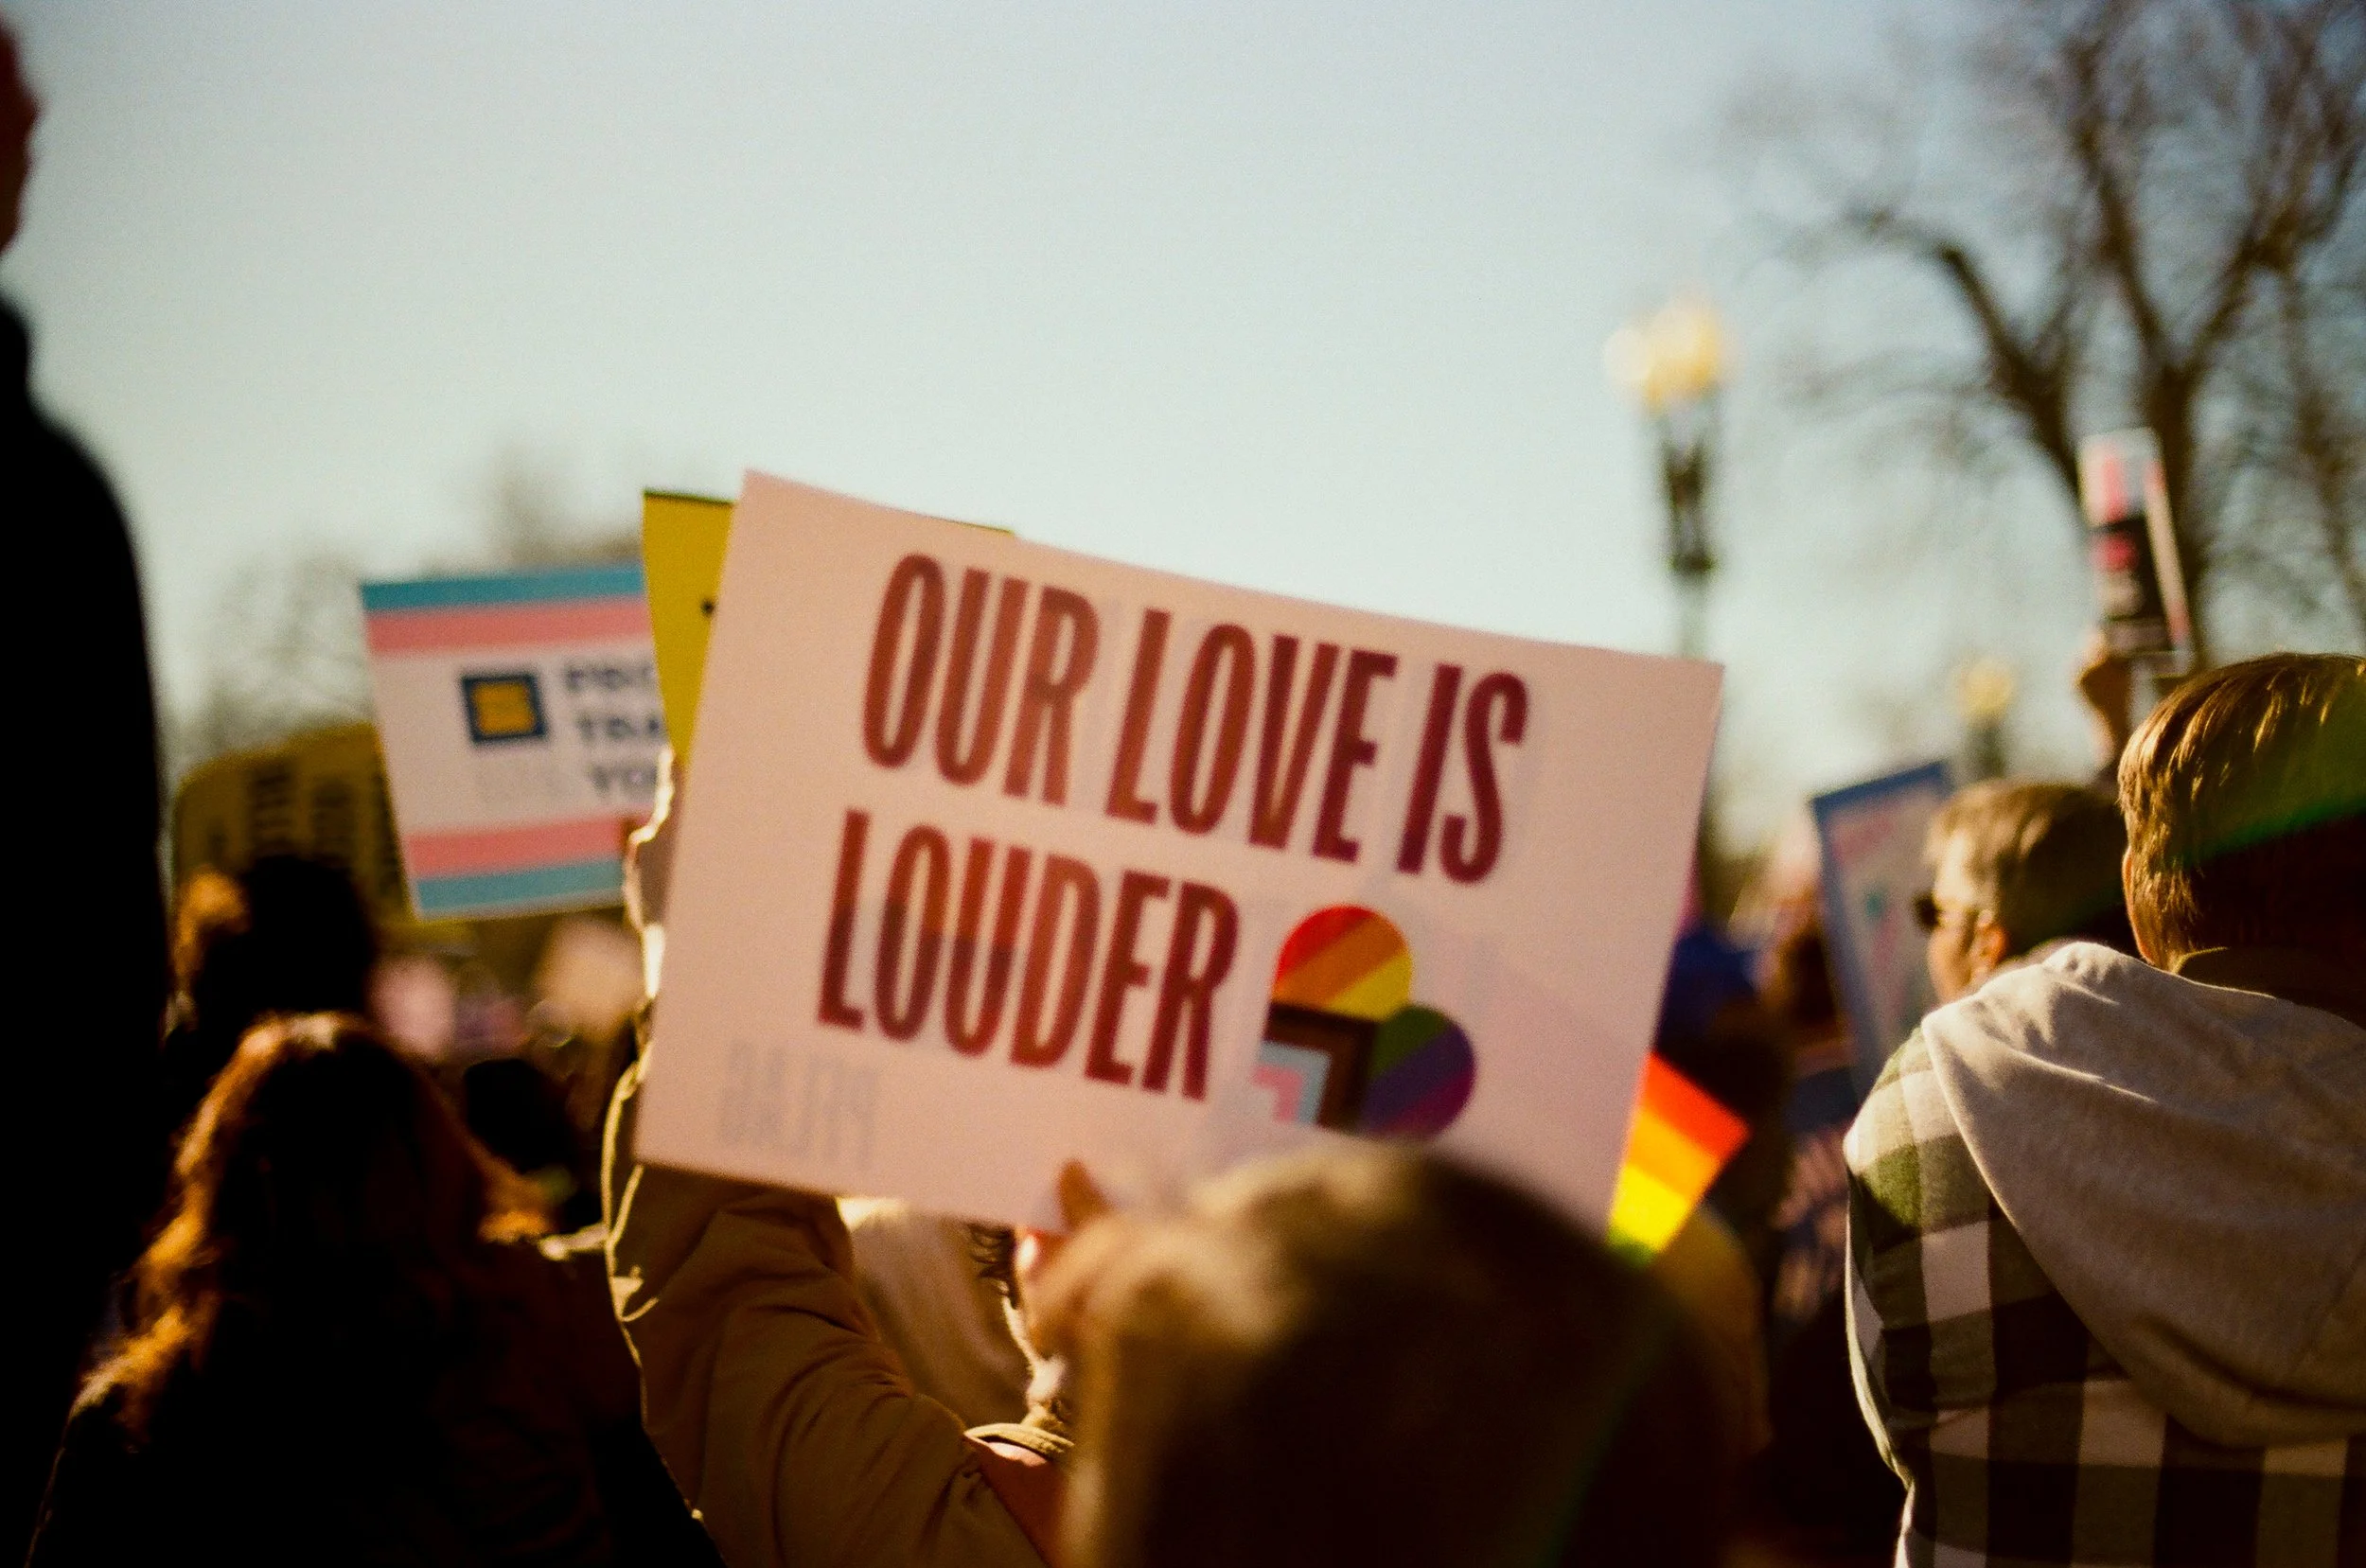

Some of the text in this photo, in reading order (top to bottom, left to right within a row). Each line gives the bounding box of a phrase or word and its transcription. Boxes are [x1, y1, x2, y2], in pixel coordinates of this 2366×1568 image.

[864, 555, 1530, 885] OUR LOVE IS
[818, 811, 1239, 1101] LOUDER
